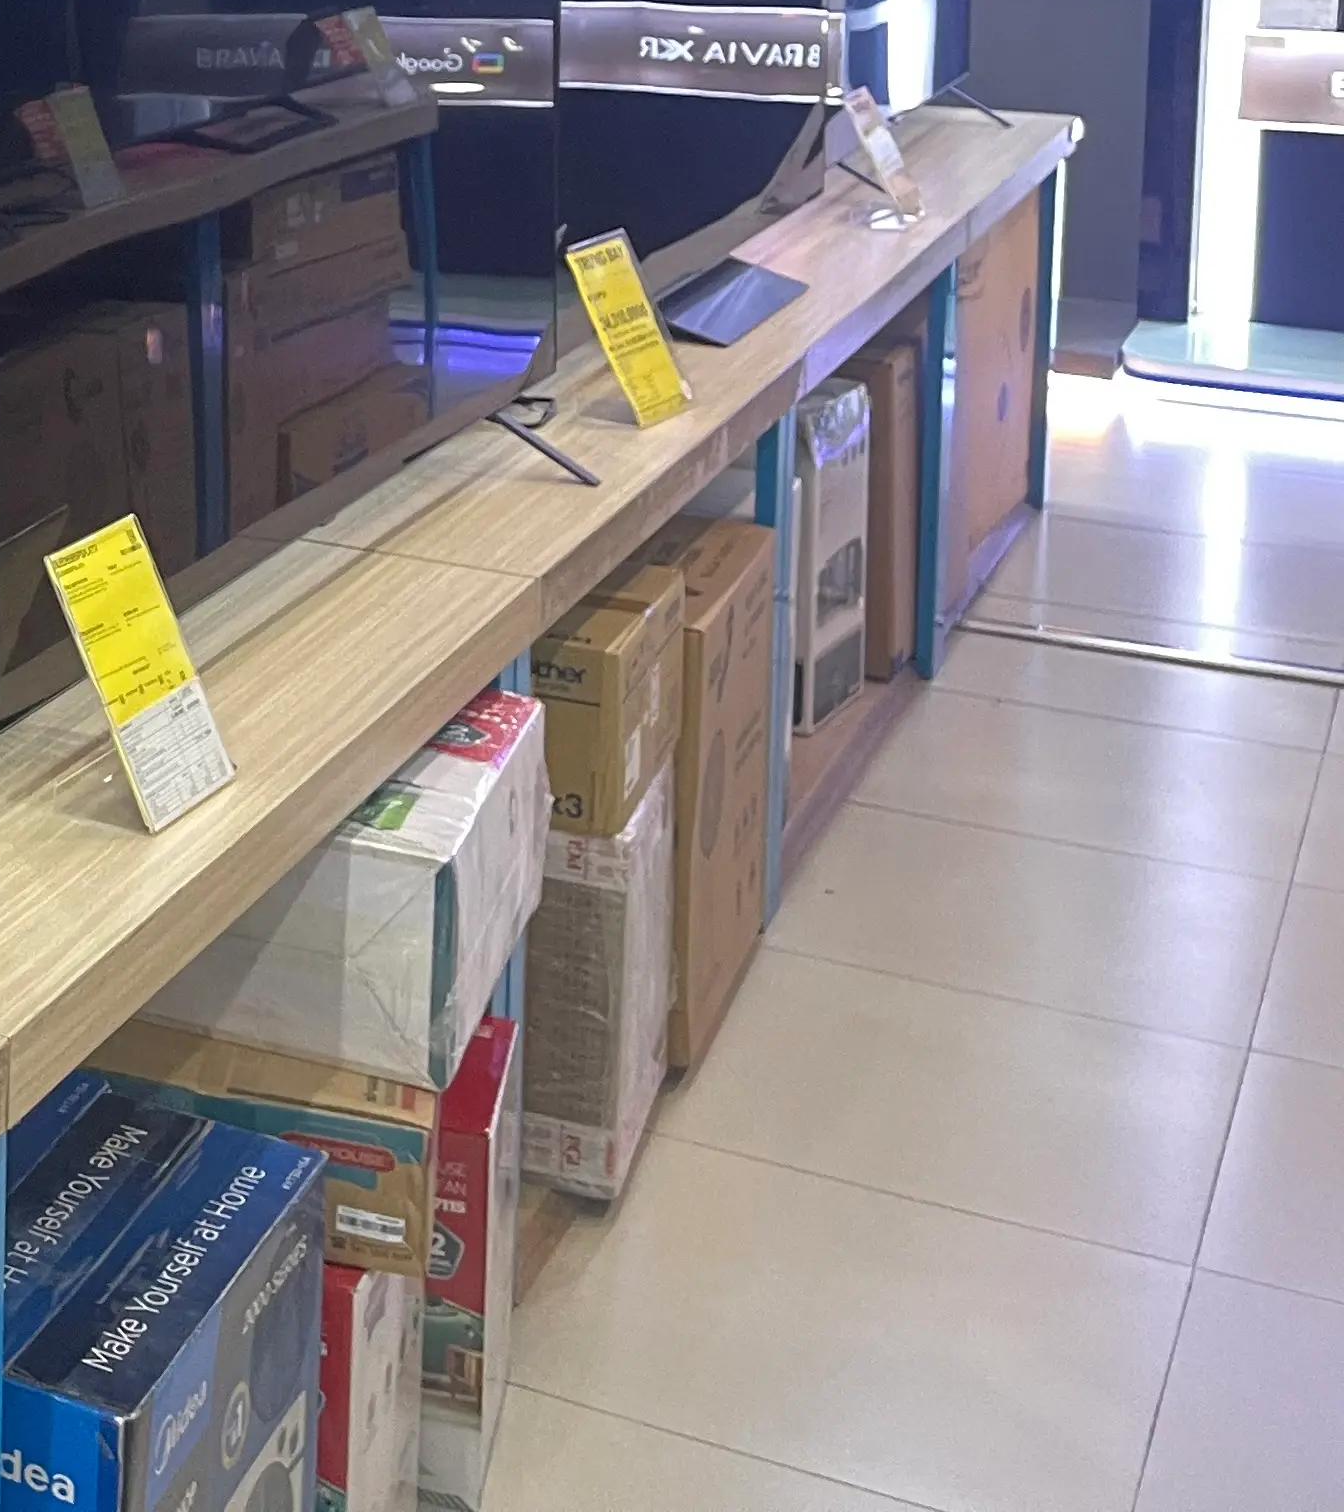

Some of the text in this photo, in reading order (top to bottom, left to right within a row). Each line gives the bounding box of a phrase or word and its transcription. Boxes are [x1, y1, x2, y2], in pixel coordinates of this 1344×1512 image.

[90, 1124, 148, 1170] Make
[32, 1172, 109, 1245] Yourself
[203, 1164, 266, 1220] Home
[8, 1236, 40, 1263] at
[193, 1207, 220, 1241] at
[125, 1238, 207, 1316] Yourself
[81, 1317, 148, 1373] Make
